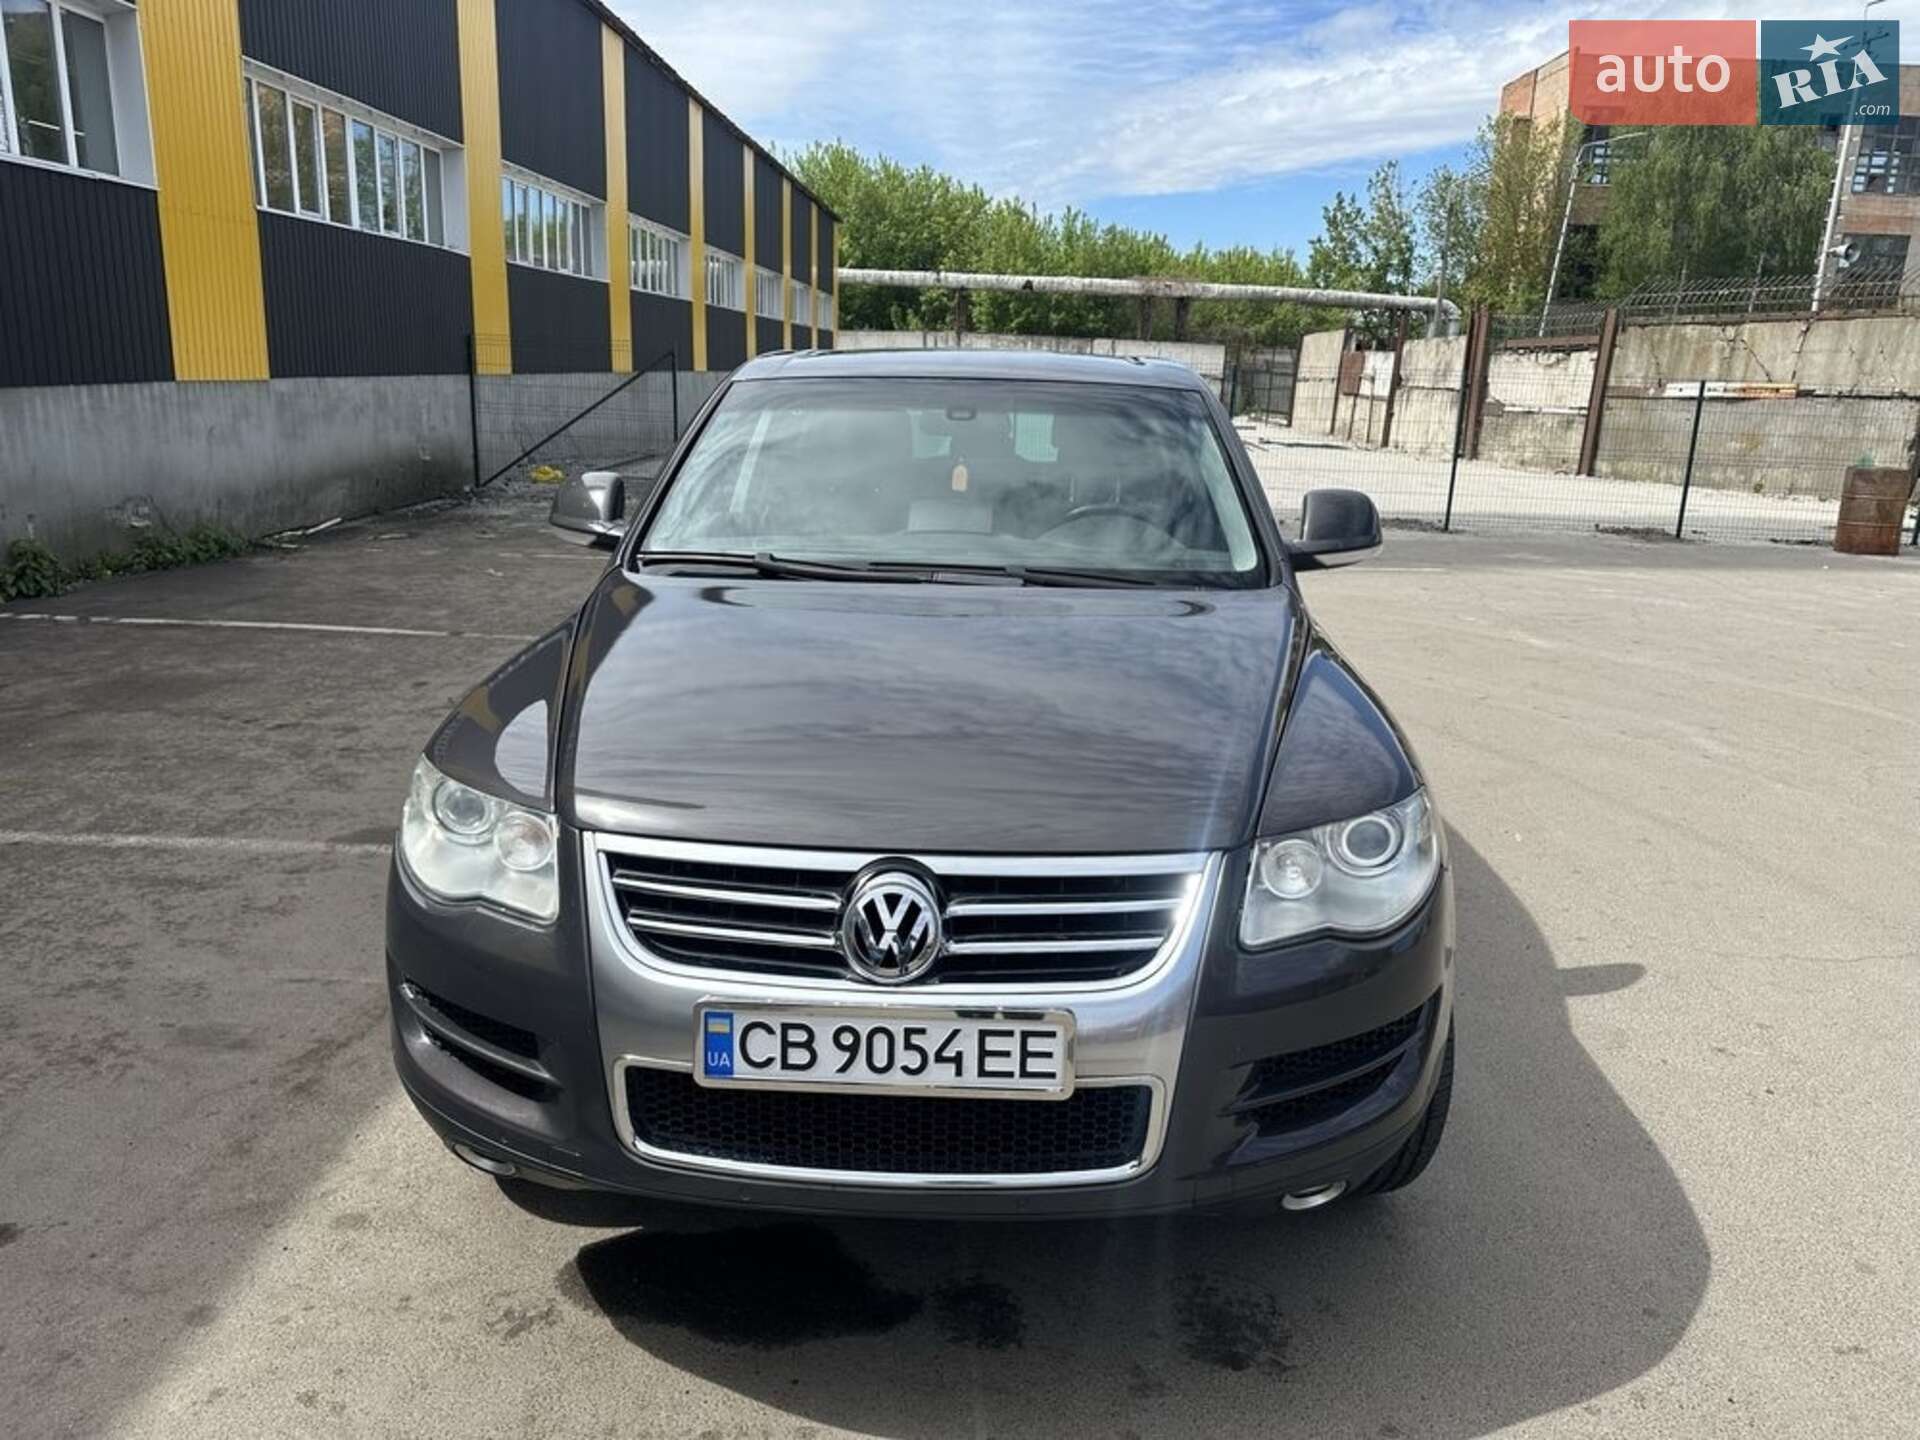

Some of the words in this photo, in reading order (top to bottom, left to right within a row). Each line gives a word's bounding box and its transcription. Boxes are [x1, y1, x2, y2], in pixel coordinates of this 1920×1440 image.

[850, 883, 935, 971] VW
[707, 1051, 732, 1069] UA
[738, 1020, 818, 1071] CB
